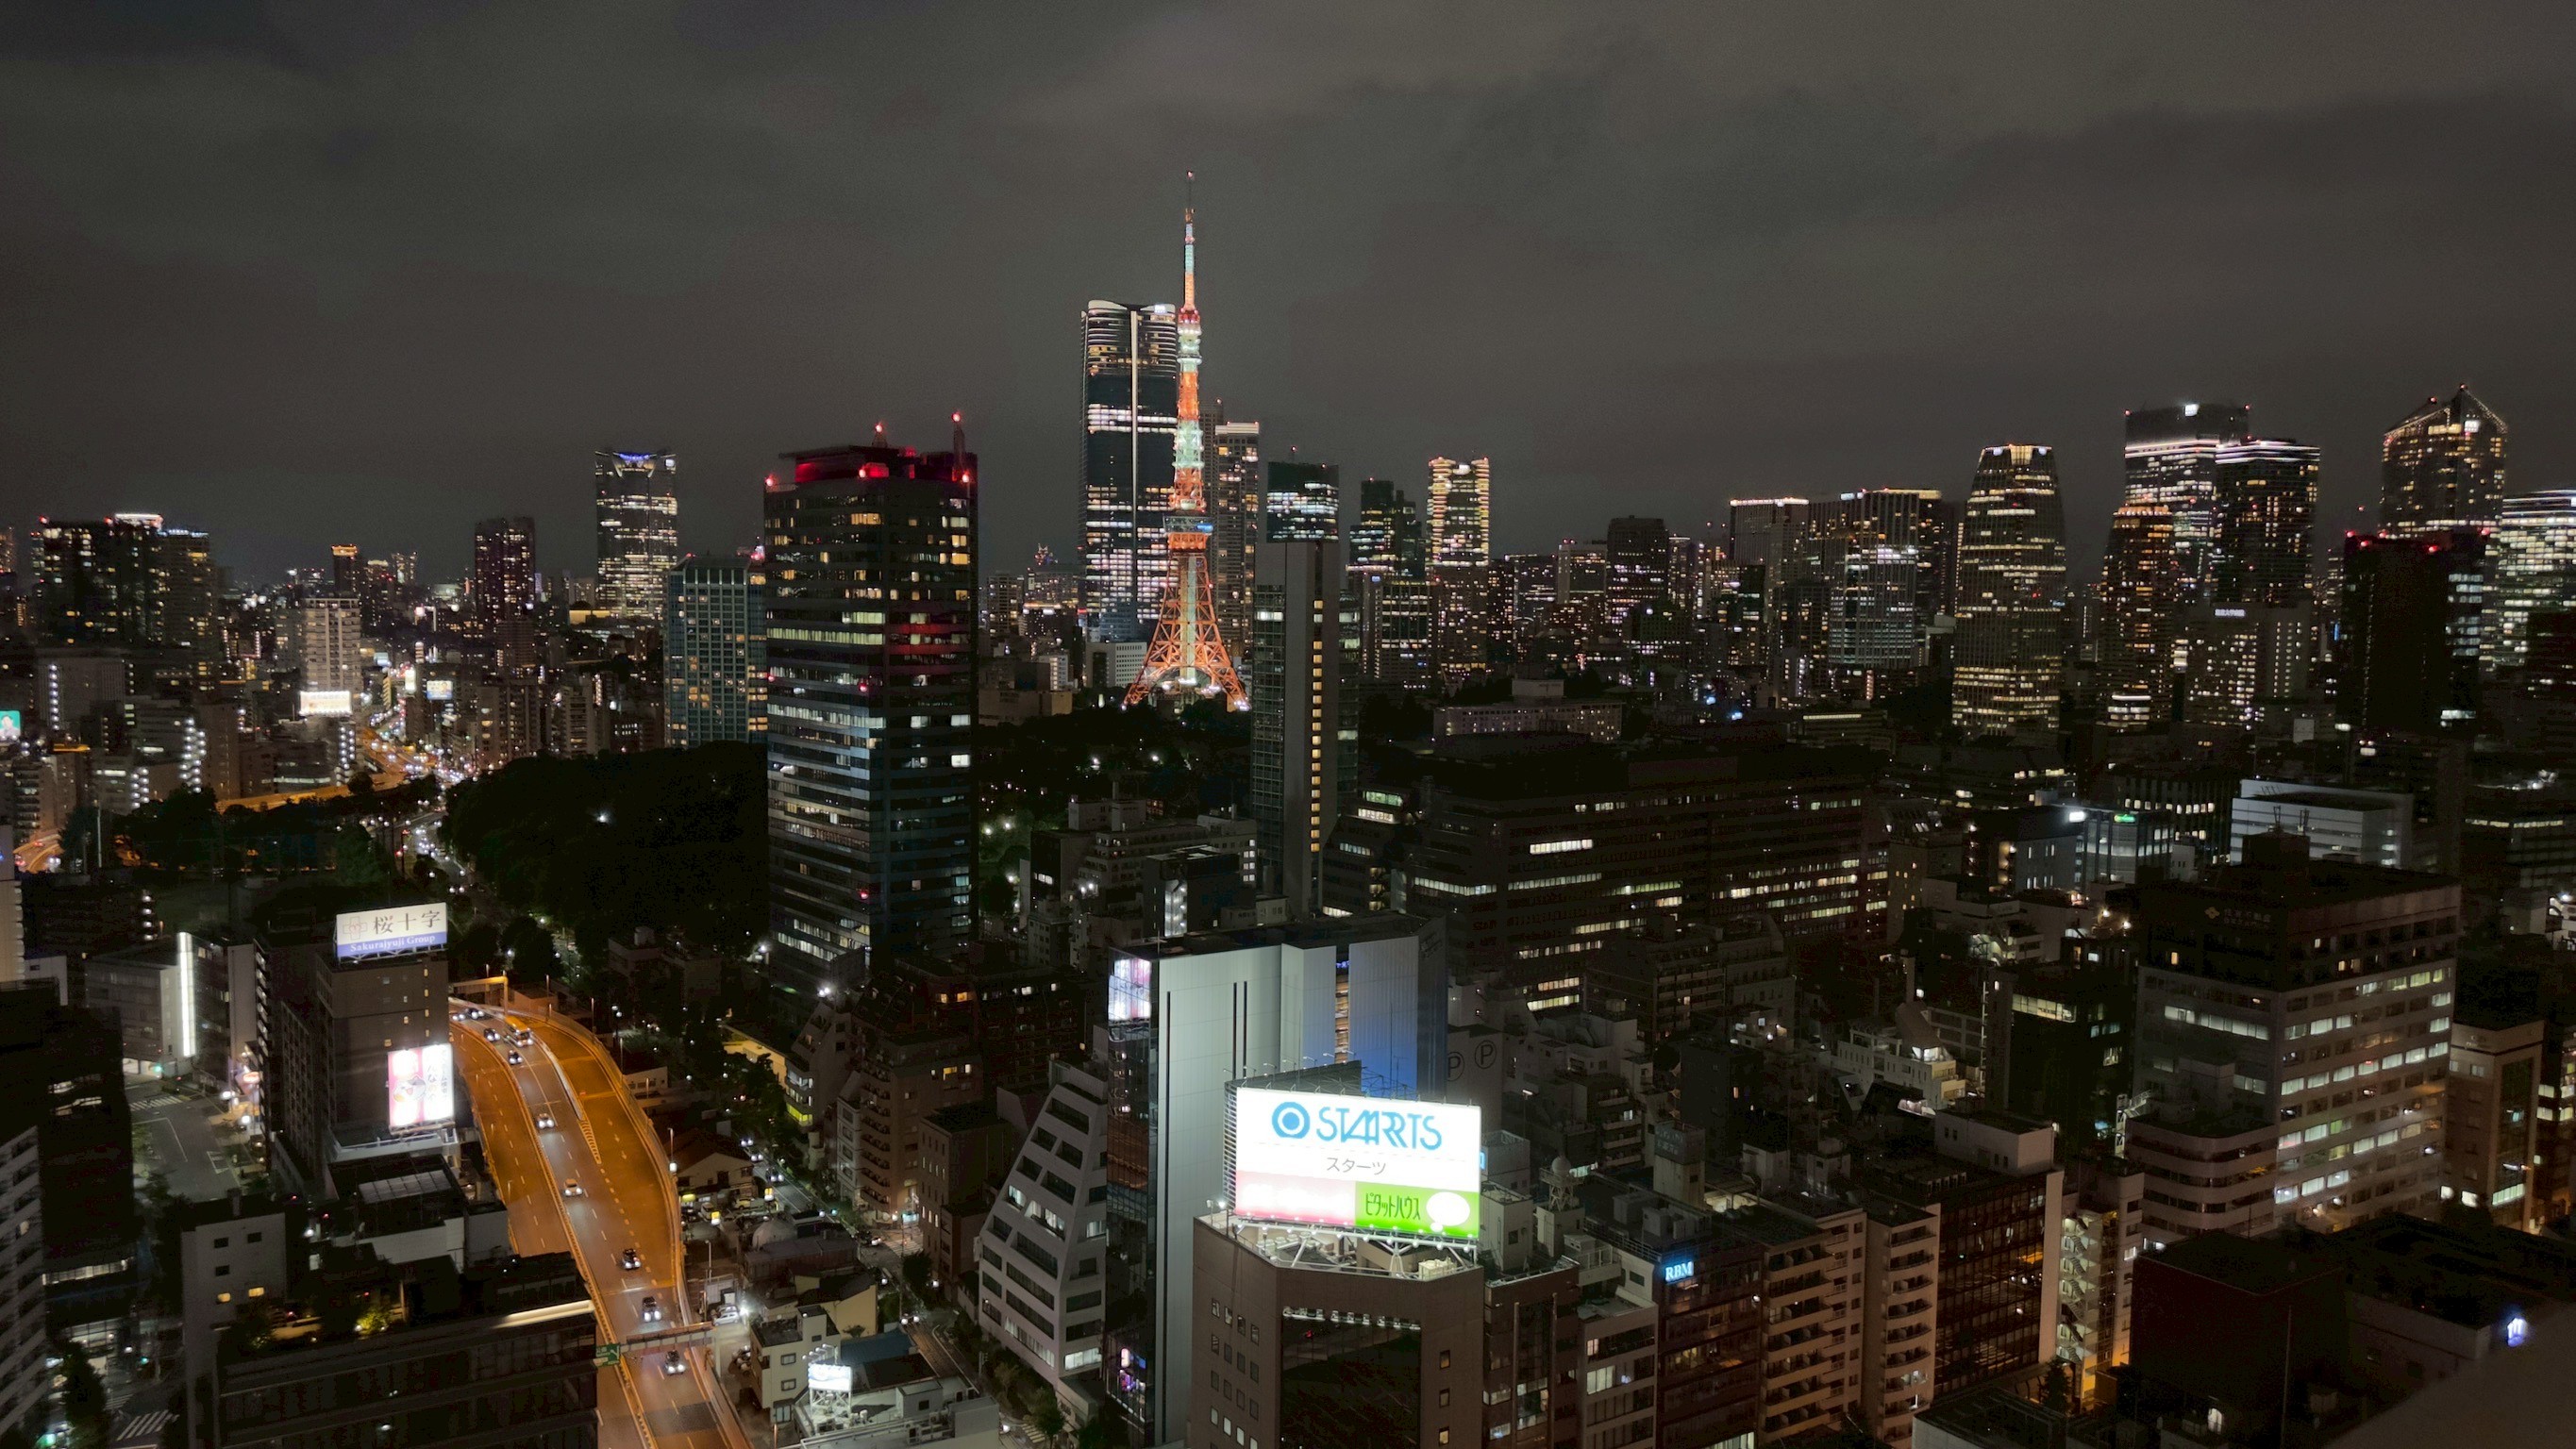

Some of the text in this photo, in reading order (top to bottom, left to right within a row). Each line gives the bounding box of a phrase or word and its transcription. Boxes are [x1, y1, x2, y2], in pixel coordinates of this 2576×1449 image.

[373, 909, 442, 935] 桜十字
[350, 935, 436, 952] Sakurajyuji Group
[1316, 1106, 1443, 1151] STARTS
[1326, 1157, 1386, 1175] スターツ
[1364, 1192, 1421, 1221] ピタットハウス
[1664, 1260, 1695, 1282] RBM
